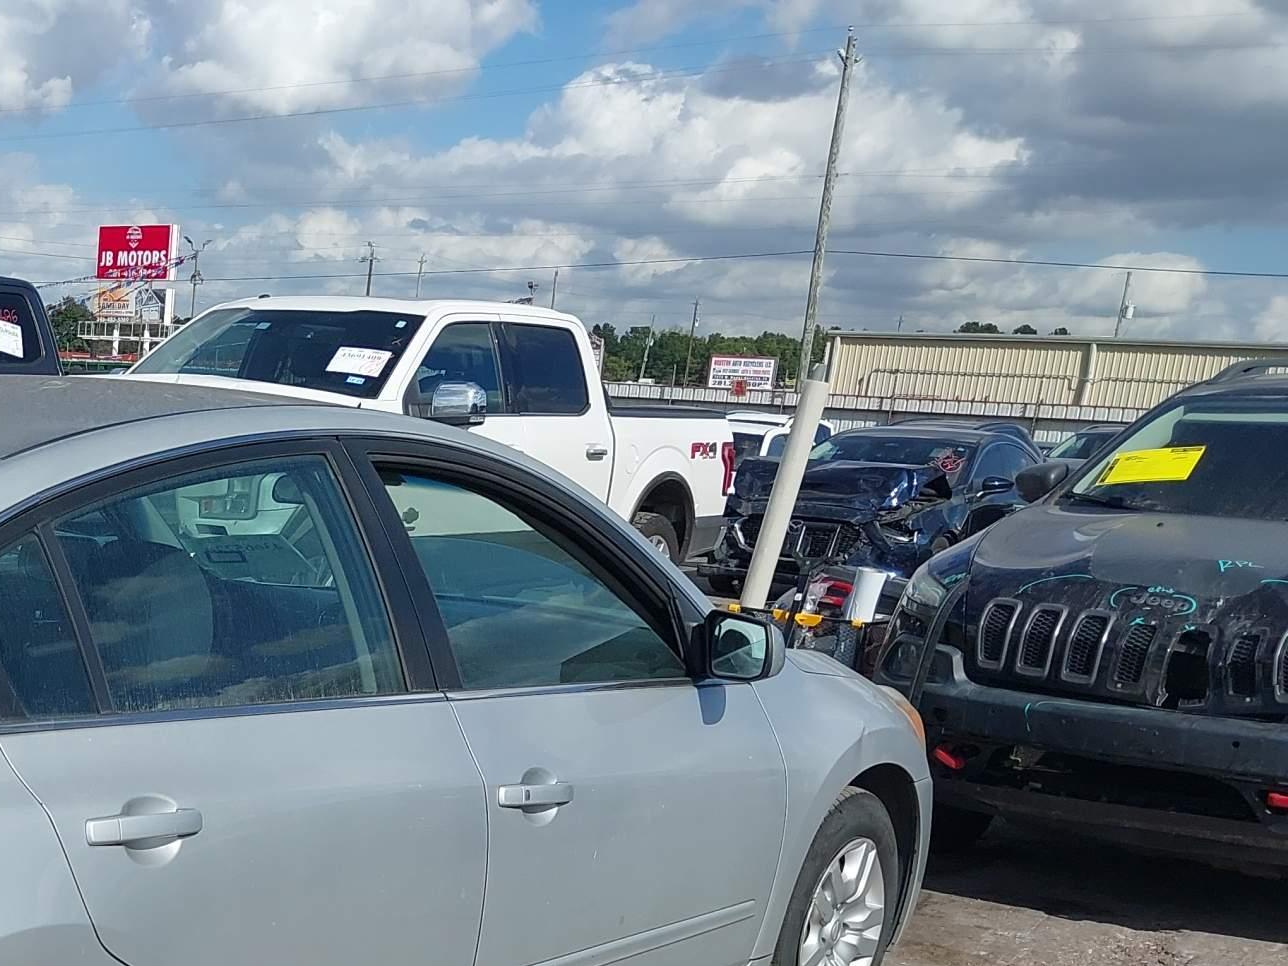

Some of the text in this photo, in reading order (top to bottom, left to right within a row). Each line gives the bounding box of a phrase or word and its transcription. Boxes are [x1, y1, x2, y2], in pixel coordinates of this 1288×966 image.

[100, 250, 166, 266] JB MOTORS
[690, 441, 718, 460] FX4
[1129, 591, 1191, 613] Jeep
